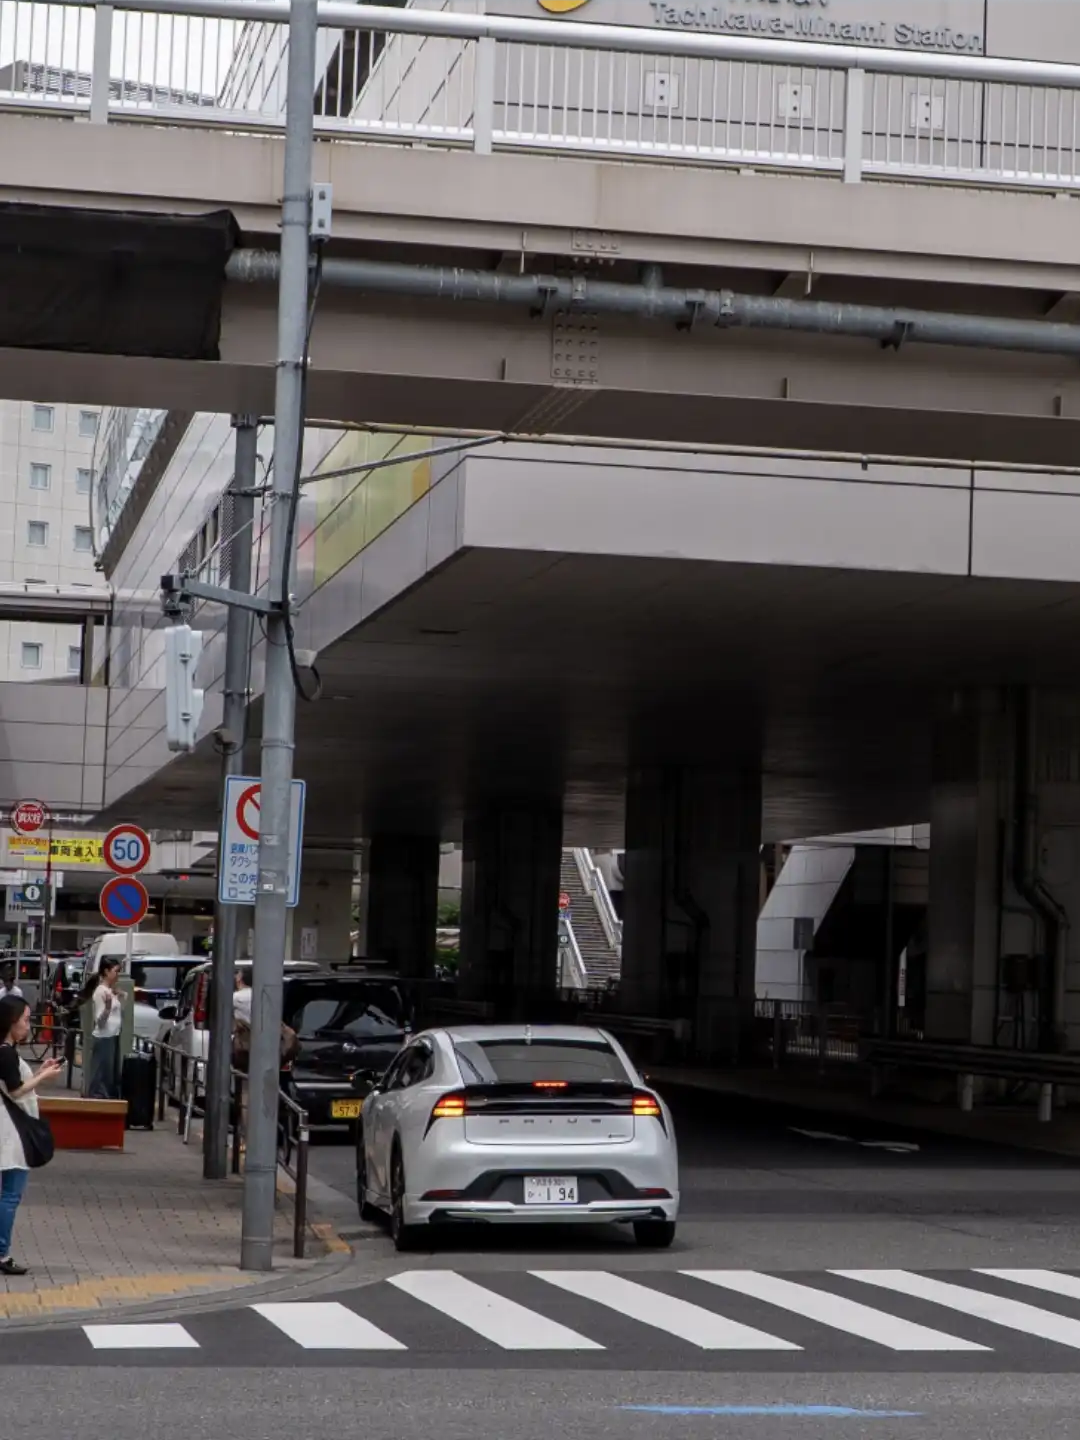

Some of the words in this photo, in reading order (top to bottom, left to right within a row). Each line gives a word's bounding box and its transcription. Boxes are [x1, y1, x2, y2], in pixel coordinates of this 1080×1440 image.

[649, 1, 886, 44] Tachikawa-Minami
[894, 22, 984, 52] Station
[113, 839, 140, 862] 50
